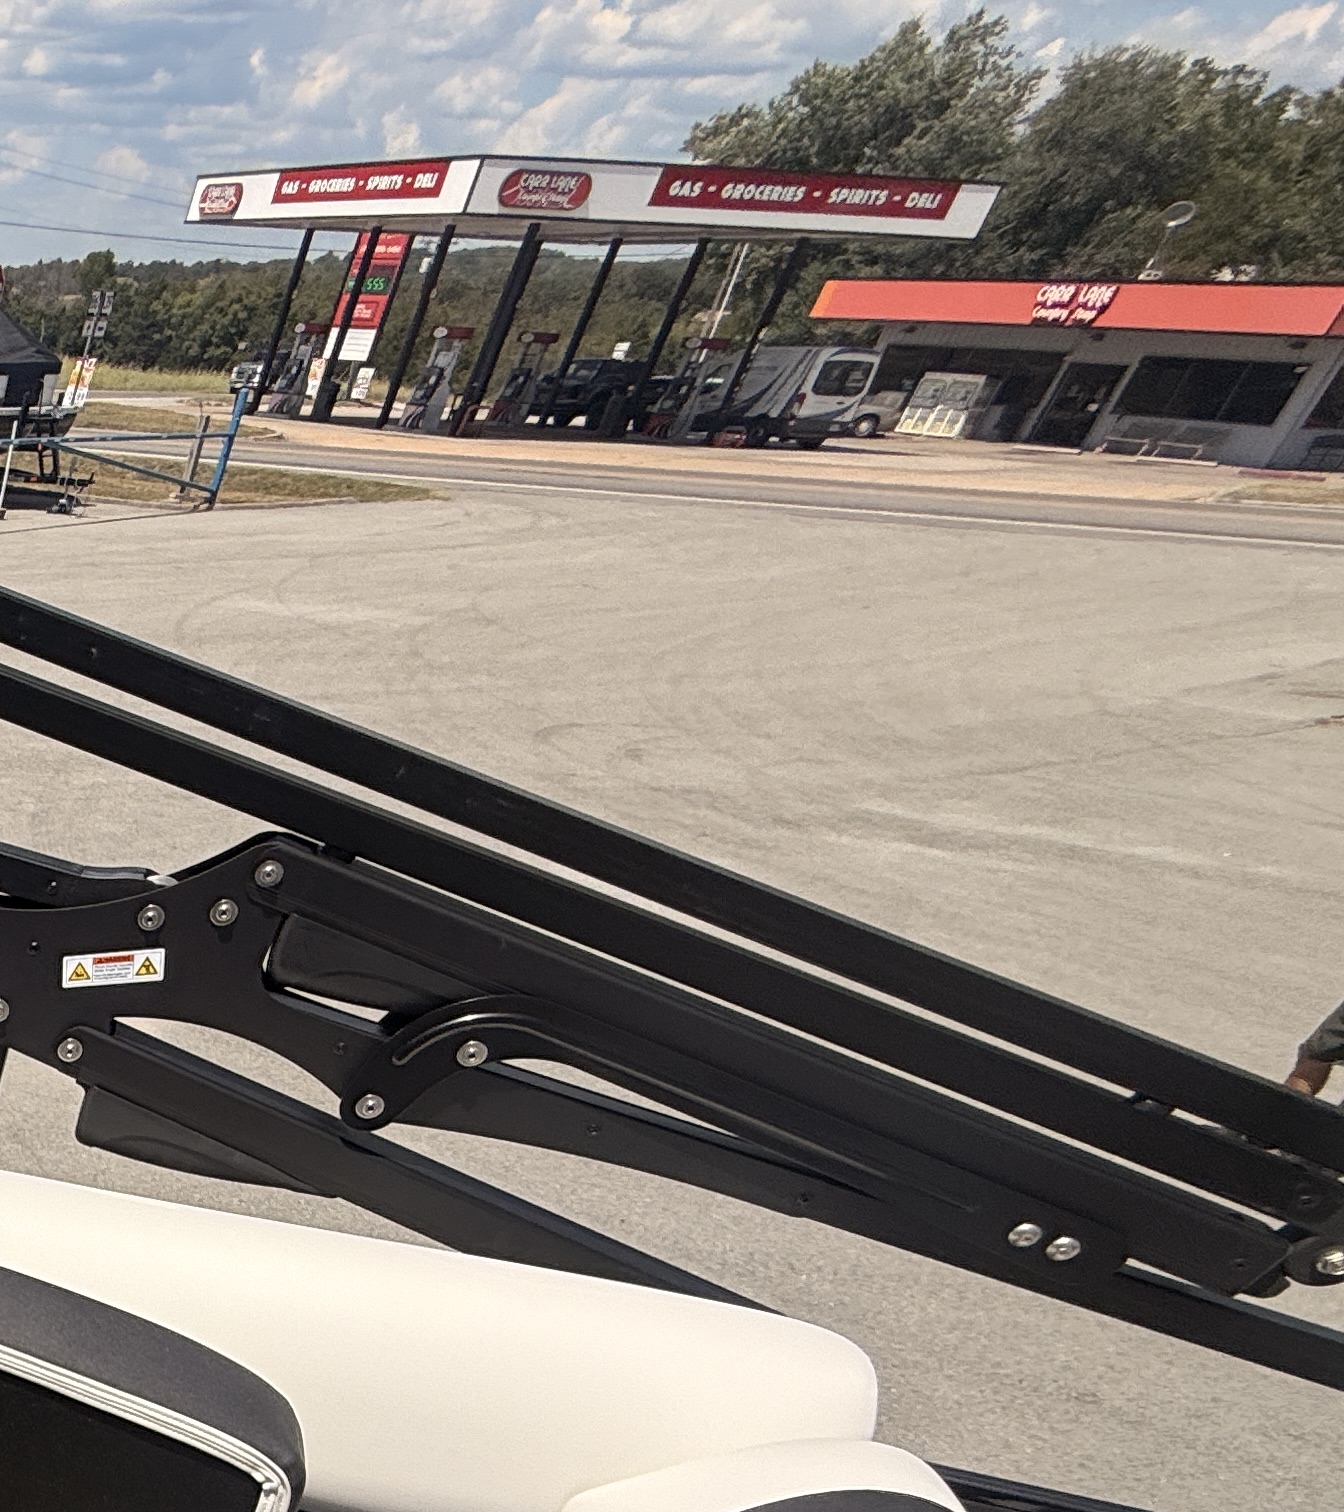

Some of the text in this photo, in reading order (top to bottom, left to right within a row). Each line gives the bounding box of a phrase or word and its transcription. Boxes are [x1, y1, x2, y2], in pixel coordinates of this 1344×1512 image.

[281, 172, 440, 195] GAS GROCERIES SPIRITS DELI
[668, 180, 943, 209] GAS GROCERIES SPIRITS DELI
[1078, 283, 1119, 308] LANE
